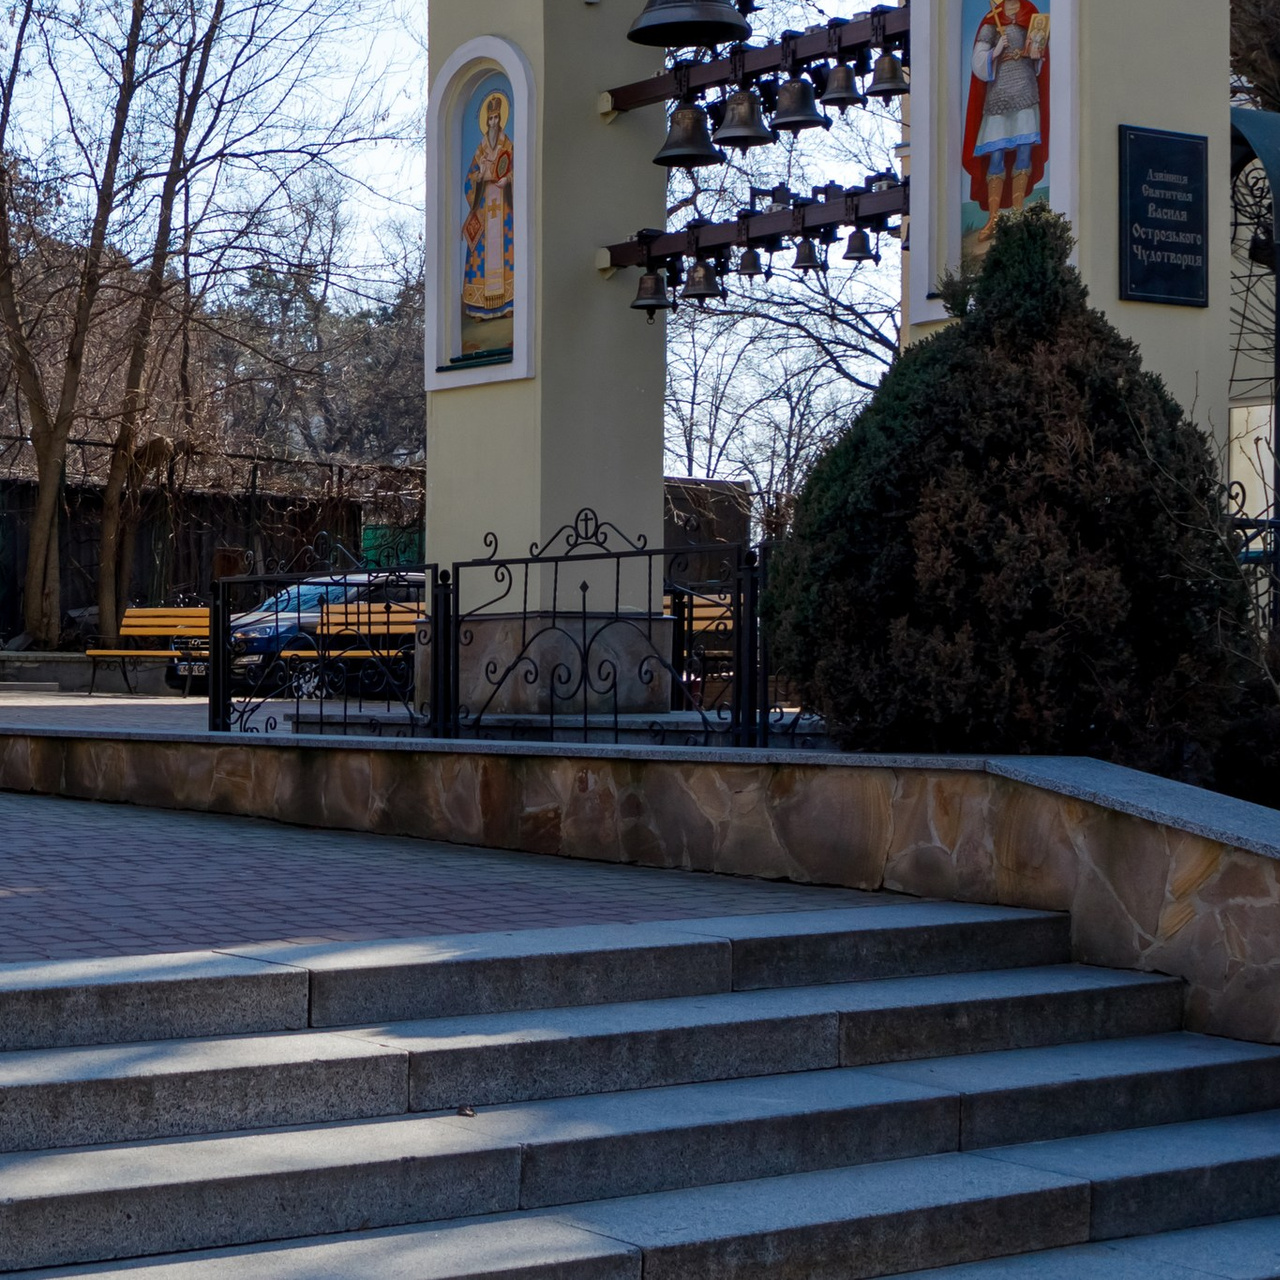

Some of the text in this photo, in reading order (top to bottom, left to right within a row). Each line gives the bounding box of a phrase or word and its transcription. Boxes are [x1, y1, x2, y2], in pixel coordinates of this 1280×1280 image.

[1141, 184, 1193, 202] Святителя
[1147, 203, 1187, 221] Василя
[1132, 223, 1202, 246] Острозького
[1132, 244, 1202, 269] Чудотворця
